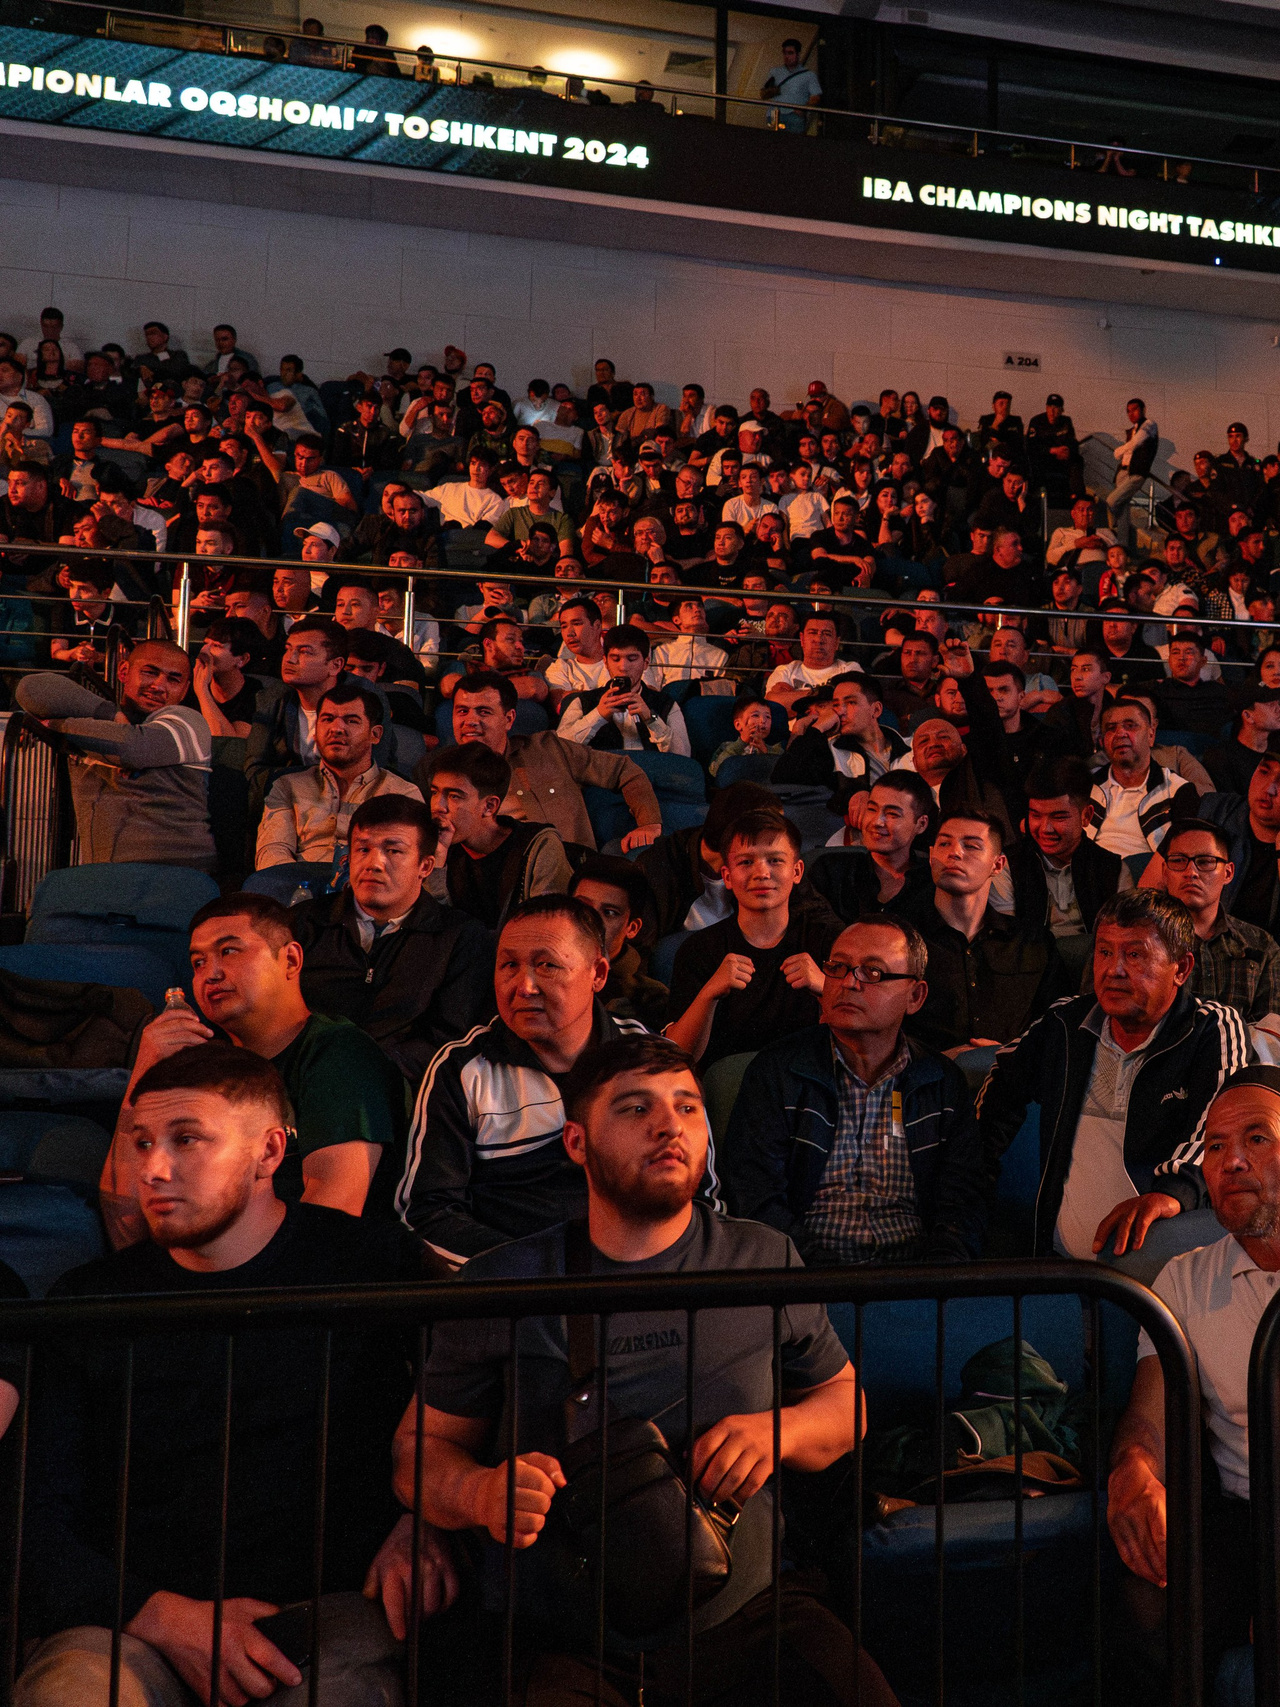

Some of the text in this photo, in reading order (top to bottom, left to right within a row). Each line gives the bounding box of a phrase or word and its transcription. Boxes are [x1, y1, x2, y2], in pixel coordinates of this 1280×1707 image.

[0, 61, 172, 108] PIONLAR
[384, 112, 558, 157] TOSHKENT
[562, 137, 650, 169] 2024
[863, 176, 914, 203] IBA
[919, 184, 1092, 224] CHAMPIONS
[1097, 205, 1184, 235] NIGHT
[1005, 355, 1039, 367] A 204
